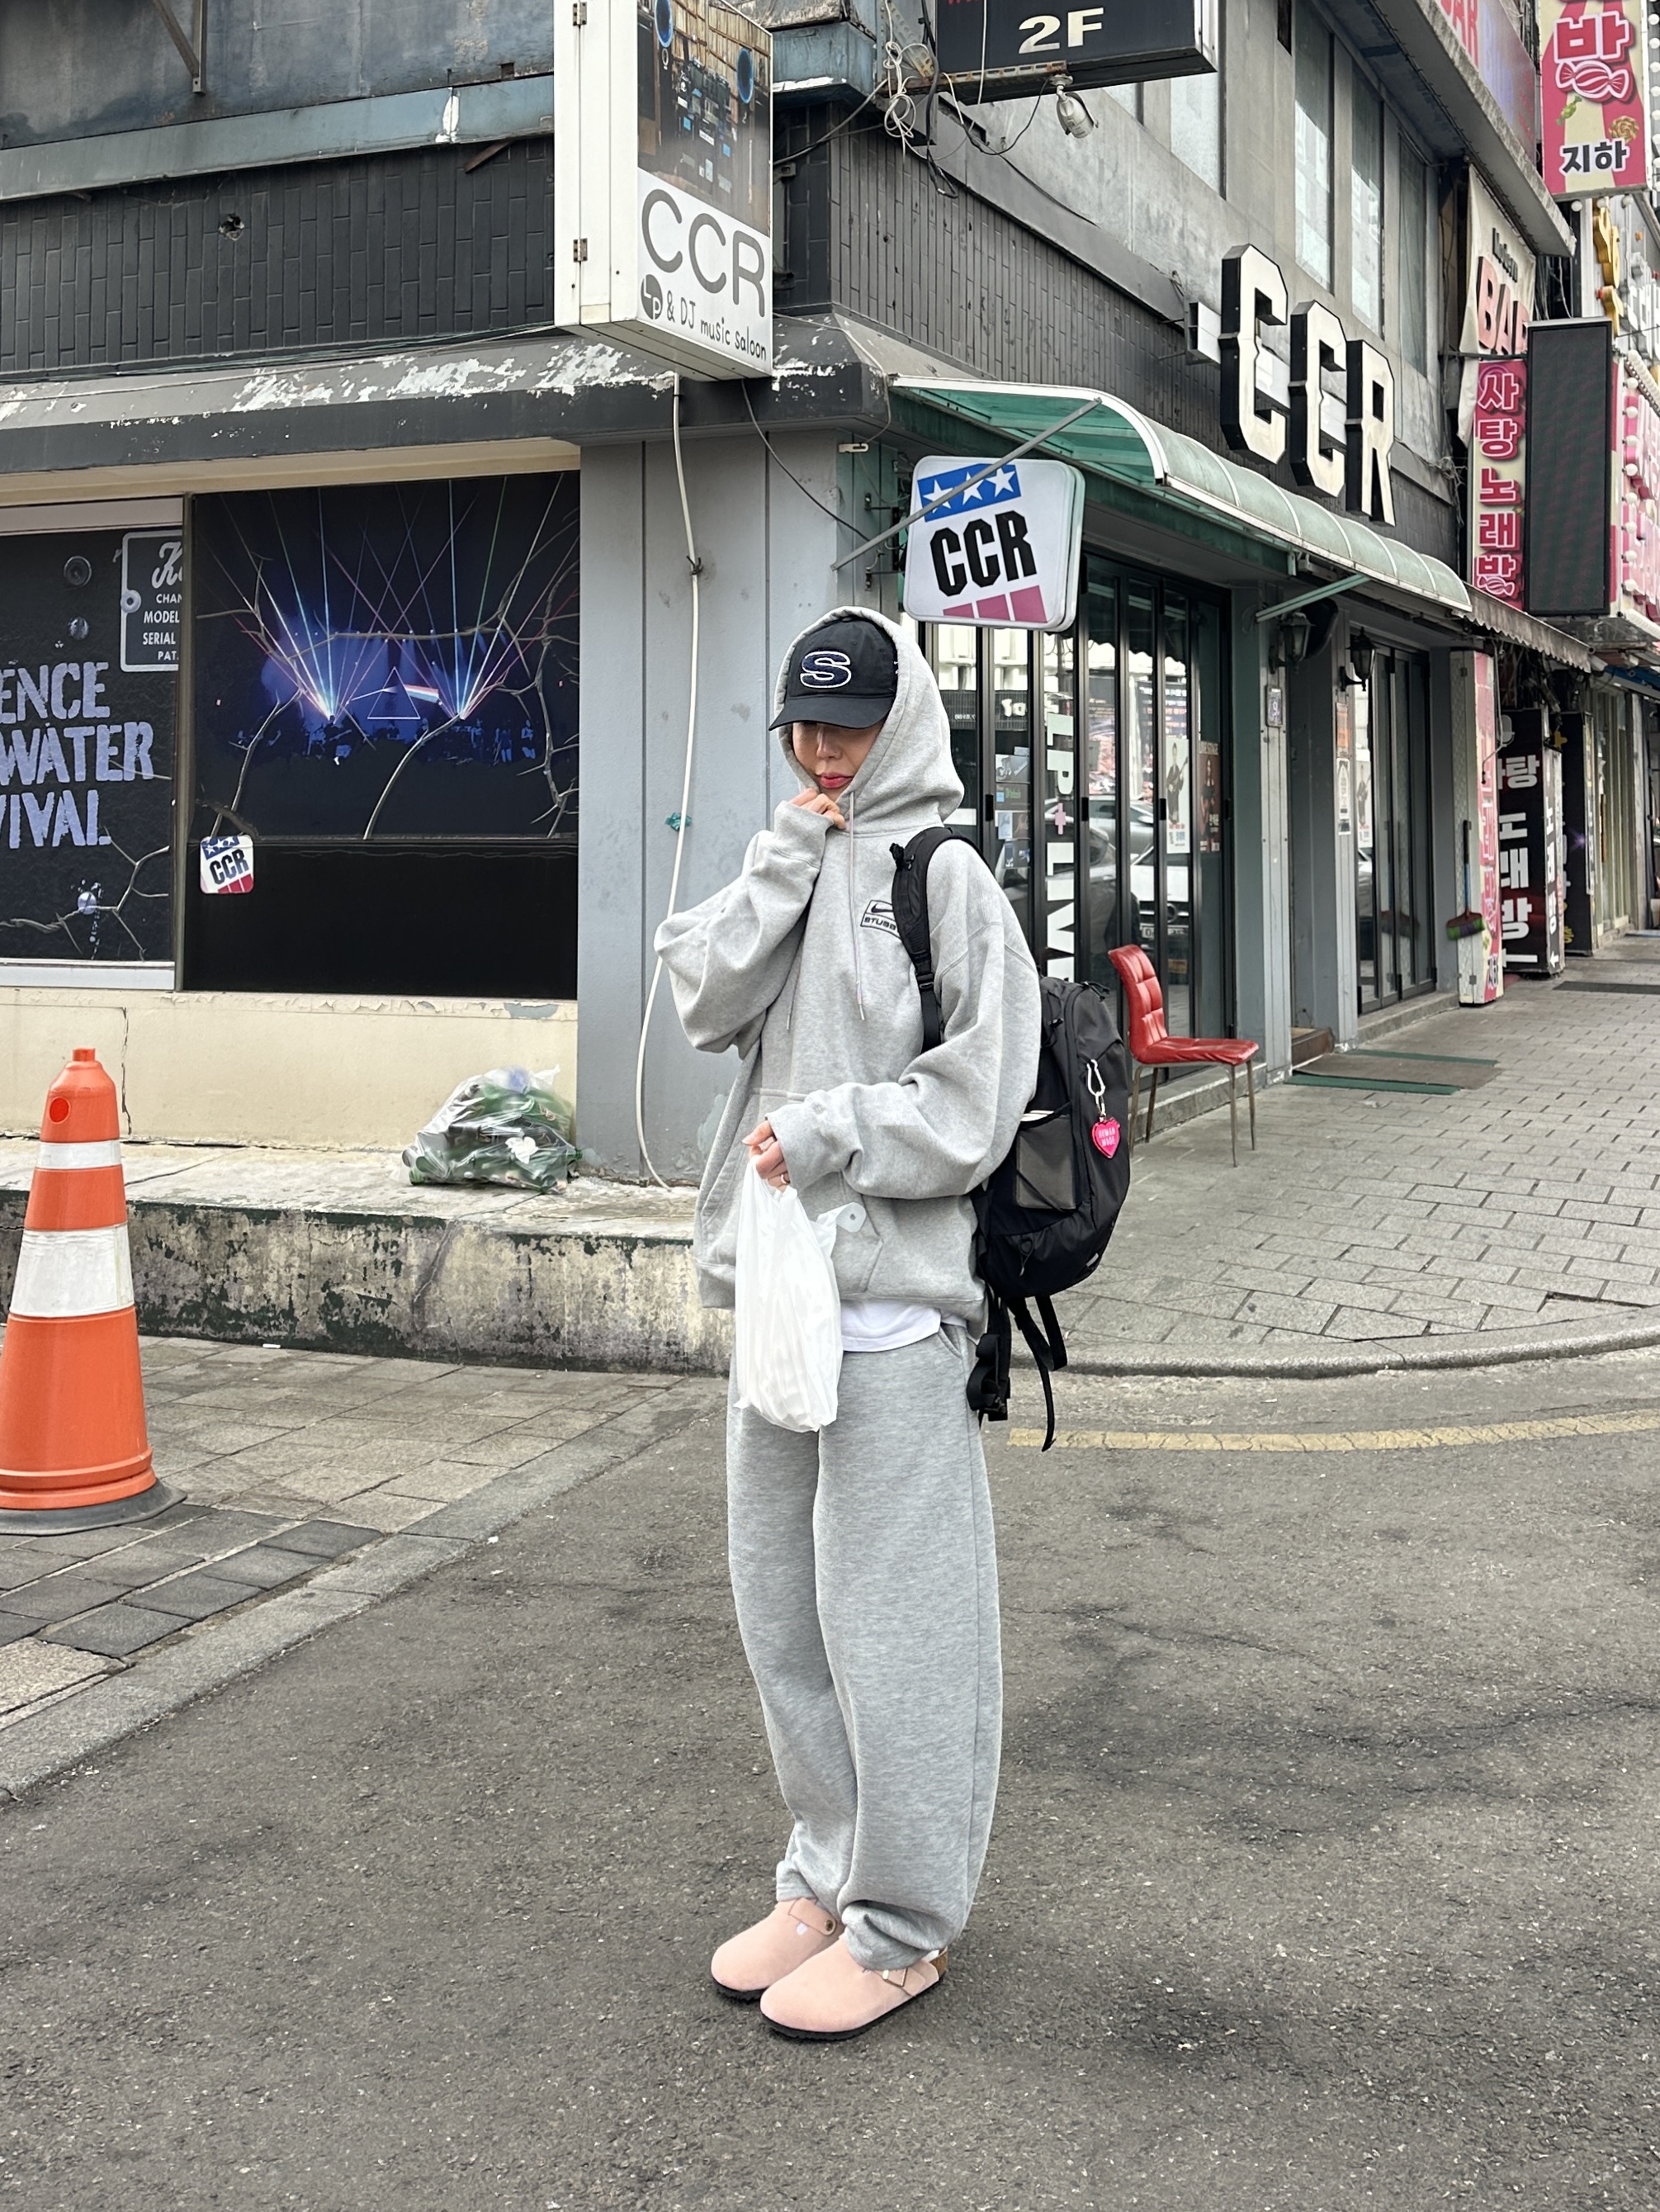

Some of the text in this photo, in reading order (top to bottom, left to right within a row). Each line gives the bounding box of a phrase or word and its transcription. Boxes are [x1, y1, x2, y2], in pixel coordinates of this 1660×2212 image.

[1019, 7, 1104, 54] 2F
[1561, 140, 1628, 174] 지하
[641, 188, 765, 318] CCR
[666, 290, 675, 323] &
[680, 296, 696, 329] DJ
[700, 316, 731, 346] music
[735, 326, 767, 362] saloon
[1219, 244, 1397, 527] CCR
[929, 510, 1038, 597] CCR
[142, 632, 177, 646] SERIAL
[143, 610, 180, 624] MODEL
[0, 661, 111, 724] ENCE
[800, 650, 852, 689] S
[0, 721, 154, 785] WATER
[1047, 713, 1075, 795] LP
[209, 848, 249, 885] CCR
